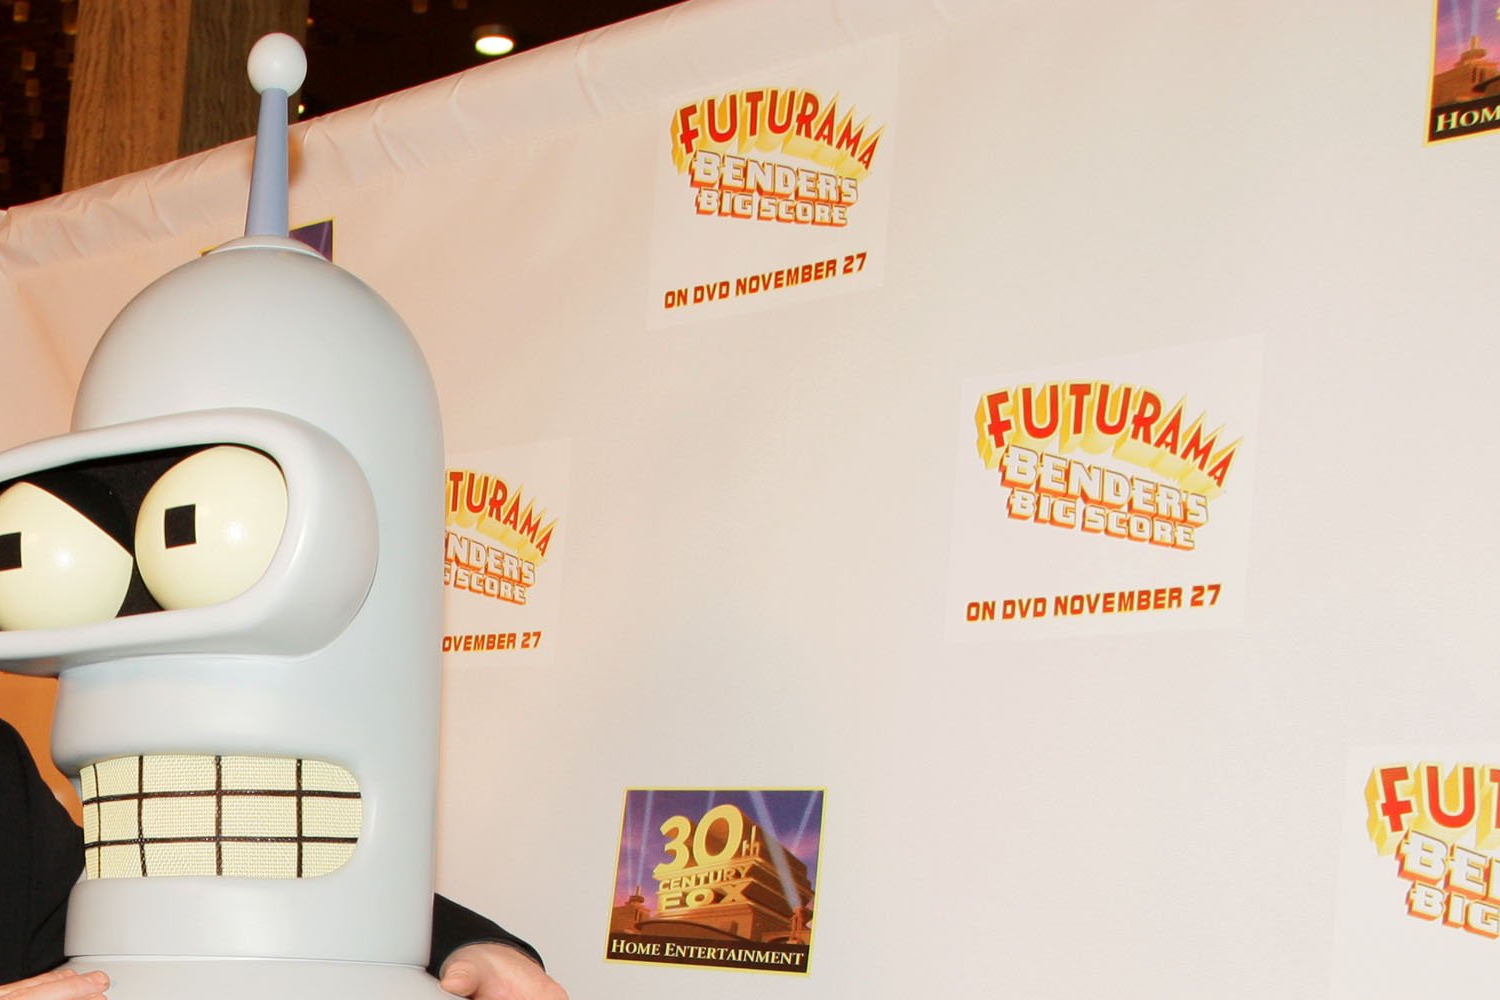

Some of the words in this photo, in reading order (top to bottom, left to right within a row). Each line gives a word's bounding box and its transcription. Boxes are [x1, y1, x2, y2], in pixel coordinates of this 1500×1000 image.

[677, 88, 883, 171] FUTURAMA
[690, 150, 859, 206] BENDER'S
[697, 188, 755, 219] BIG
[757, 197, 848, 227] SCORE
[664, 288, 688, 309] ON
[693, 280, 730, 305] DVD
[735, 258, 838, 296] NOVEMBER
[843, 252, 868, 275] 27
[987, 383, 1236, 488] FUTURAMA
[449, 471, 555, 557] TURAMA
[1000, 444, 1209, 528] BENDER'S
[1008, 489, 1077, 530] BIG
[1081, 504, 1196, 552] SCORE
[446, 532, 536, 588] NDER'S
[454, 566, 526, 605] SCORE
[966, 601, 996, 622] ON
[1002, 597, 1047, 620] DVD
[1053, 587, 1183, 616] NOVEMBER
[1190, 584, 1222, 607] 27
[442, 632, 516, 652] OVEMBER
[521, 631, 542, 649] 27
[658, 865, 751, 893] CENTURY
[658, 881, 754, 914] FOX
[1406, 881, 1500, 939] BIG
[611, 938, 660, 956] HOME
[664, 942, 804, 966] ENTERTAINMENT
